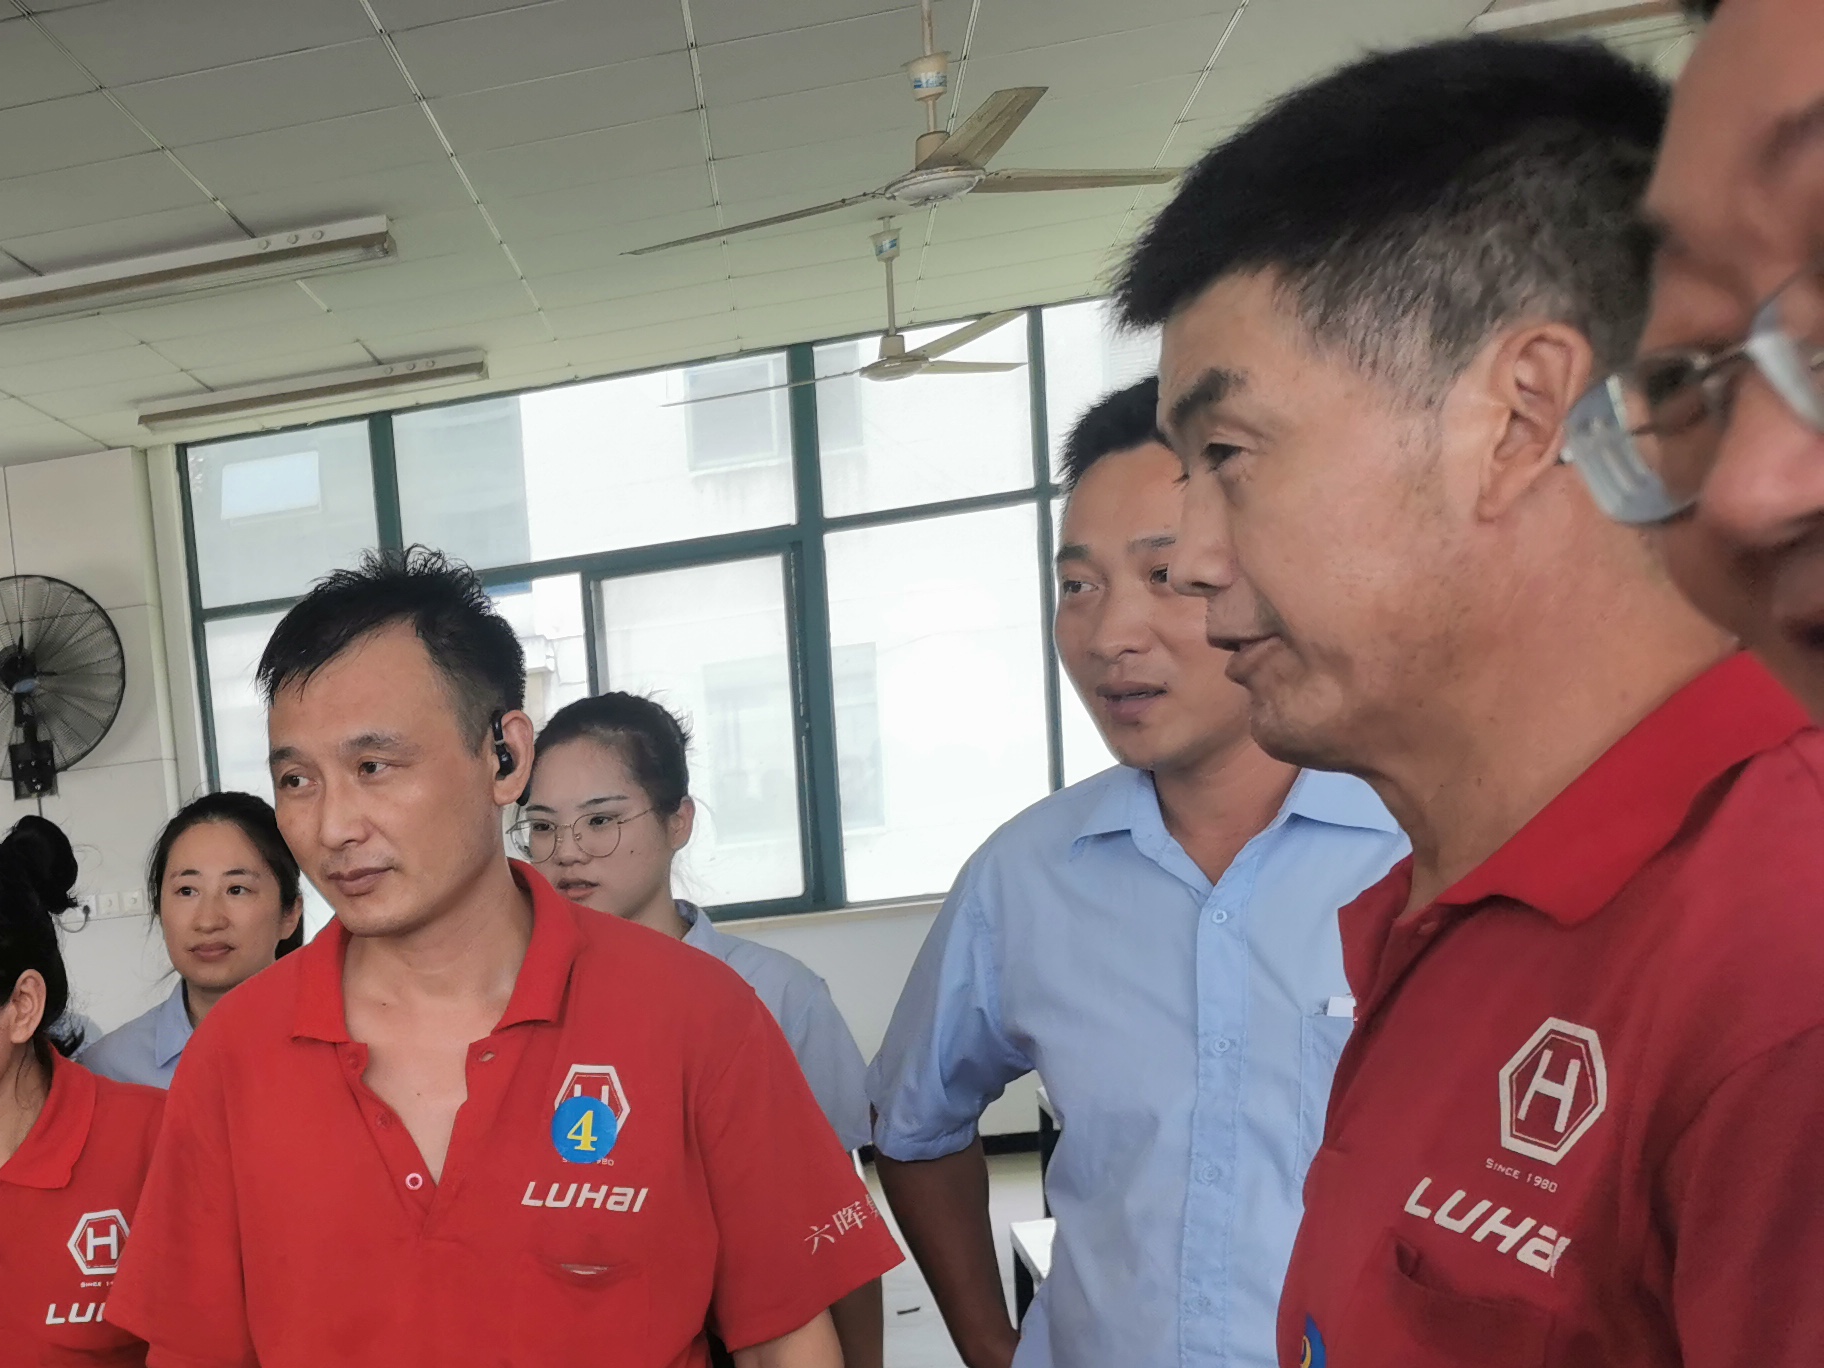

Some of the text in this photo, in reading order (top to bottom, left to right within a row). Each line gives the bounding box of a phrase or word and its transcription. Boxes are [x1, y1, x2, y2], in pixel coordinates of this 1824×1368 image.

[1517, 1049, 1580, 1133] H
[567, 1110, 597, 1151] 4
[1485, 1157, 1558, 1193] SINCE 1980
[85, 1224, 119, 1261] H
